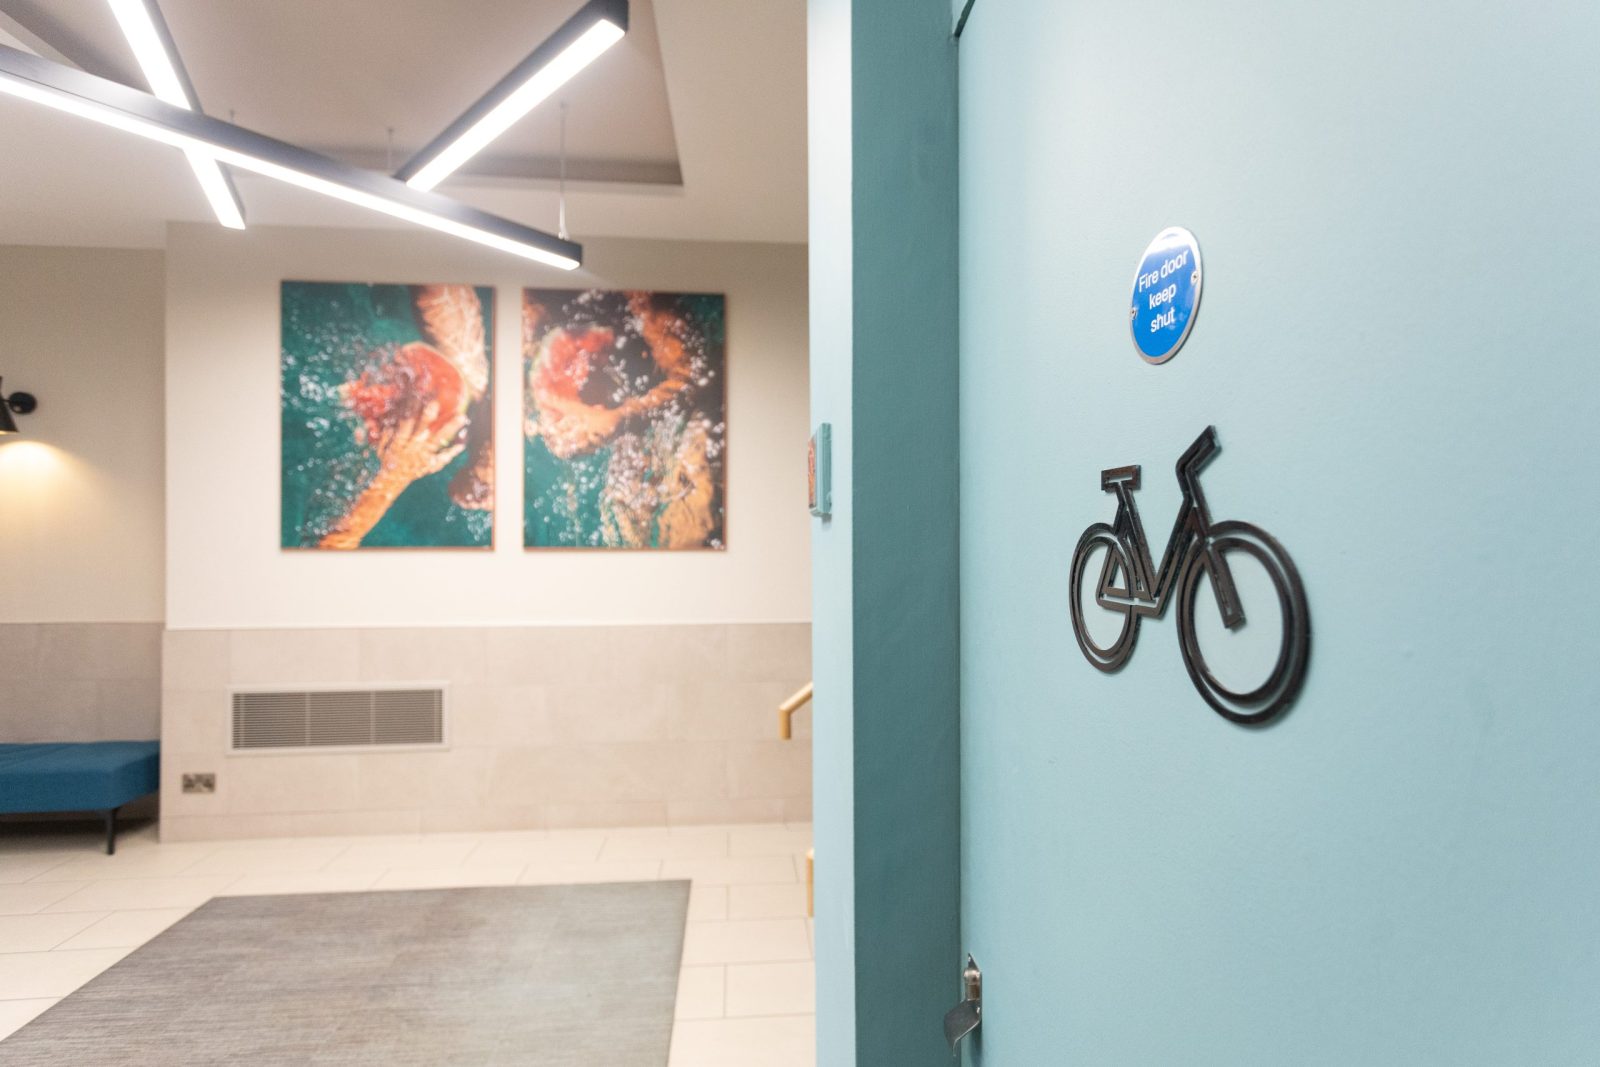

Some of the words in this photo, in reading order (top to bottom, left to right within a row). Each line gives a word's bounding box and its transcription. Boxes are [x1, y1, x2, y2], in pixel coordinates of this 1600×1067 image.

[1138, 271, 1158, 293] Fire
[1161, 249, 1189, 278] door
[1149, 283, 1176, 310] keep
[1151, 306, 1176, 333] shut
